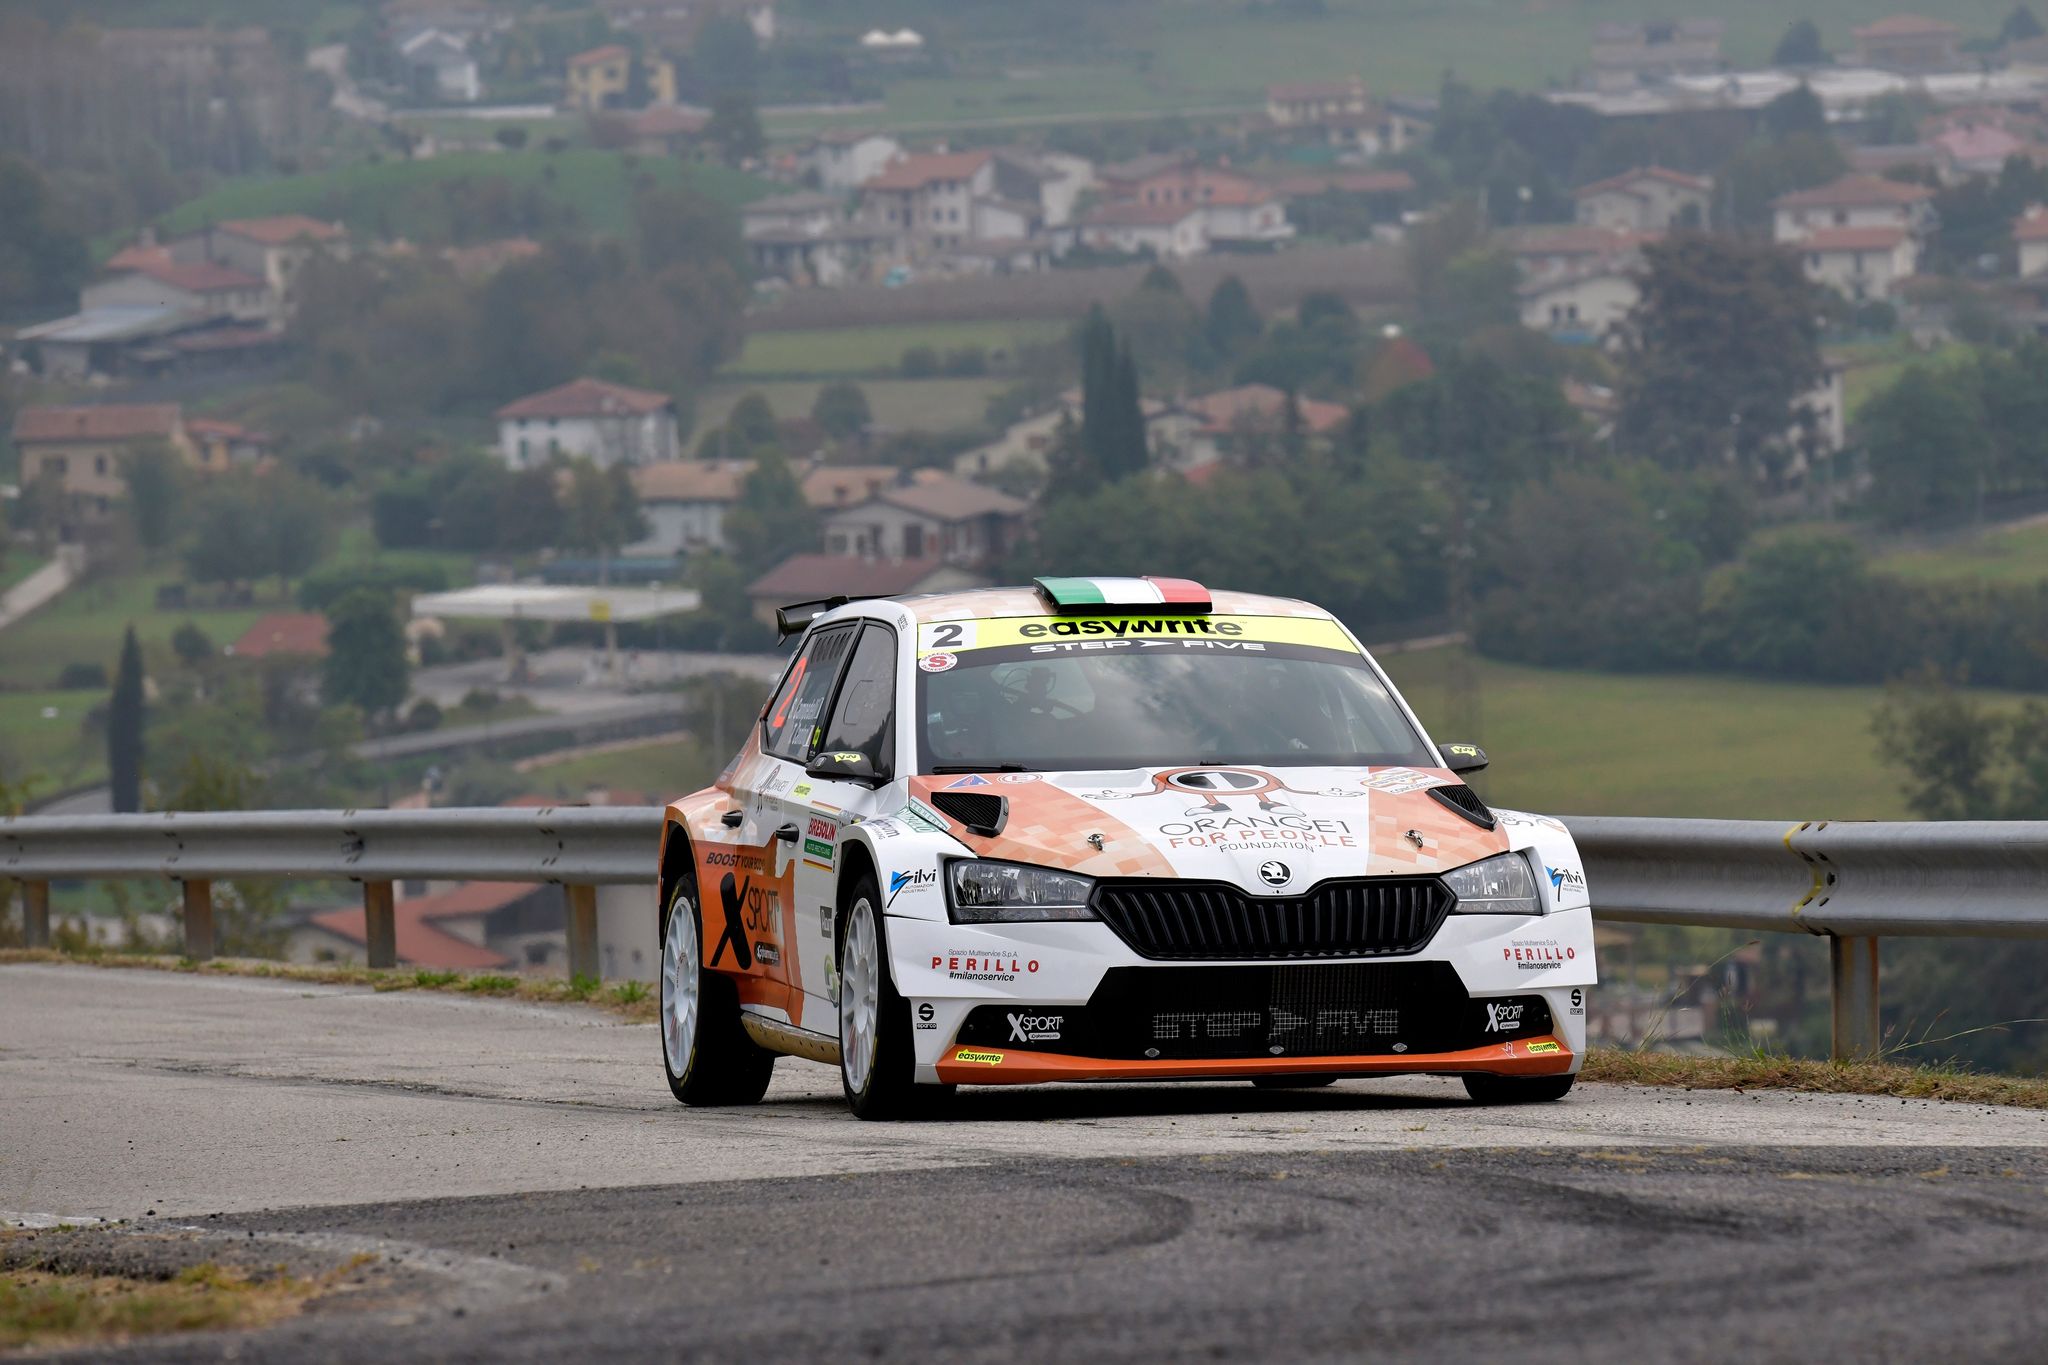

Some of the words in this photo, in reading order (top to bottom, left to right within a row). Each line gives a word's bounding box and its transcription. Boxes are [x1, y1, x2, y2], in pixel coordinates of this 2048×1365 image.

[931, 624, 963, 648] 2
[1019, 619, 1243, 638] easywrite
[1030, 640, 1132, 653] STEP
[1182, 640, 1266, 650] FIVE
[772, 656, 807, 728] 2
[808, 817, 837, 842] BRESOLIN
[1159, 816, 1351, 835] ORANGE1
[1169, 832, 1228, 849] FOR
[1240, 830, 1357, 847] PEOPLE
[1219, 841, 1314, 853] FOUNDATION
[706, 852, 741, 867] BOOST
[1504, 947, 1575, 960] PERILLO
[931, 957, 1039, 973] PERILLO
[1518, 961, 1561, 970] #milanoservice
[949, 971, 1015, 982] #milanoservice
[1153, 1012, 1261, 1039] STEP
[1316, 1009, 1399, 1034] FIVE
[958, 1051, 1001, 1063] easywrite
